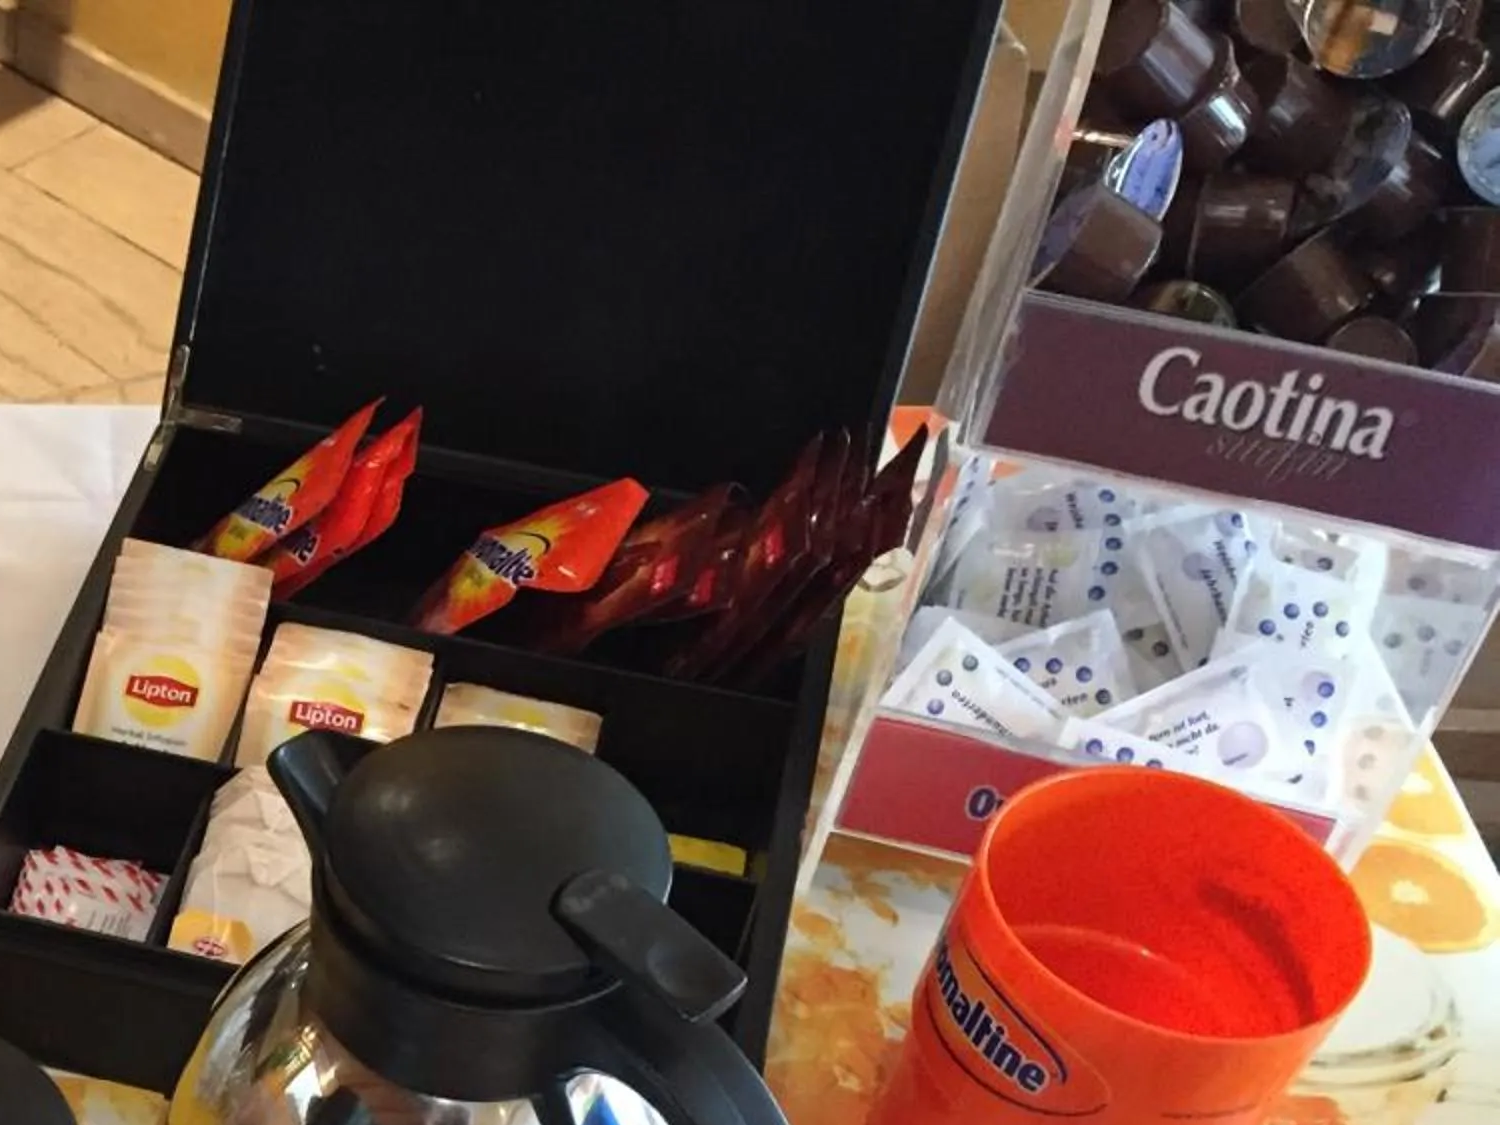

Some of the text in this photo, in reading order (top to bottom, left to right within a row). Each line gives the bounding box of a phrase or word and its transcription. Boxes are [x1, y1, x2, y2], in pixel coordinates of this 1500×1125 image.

[1138, 346, 1395, 459] Caotina
[131, 679, 192, 704] Lipton
[295, 703, 358, 730] Lipton
